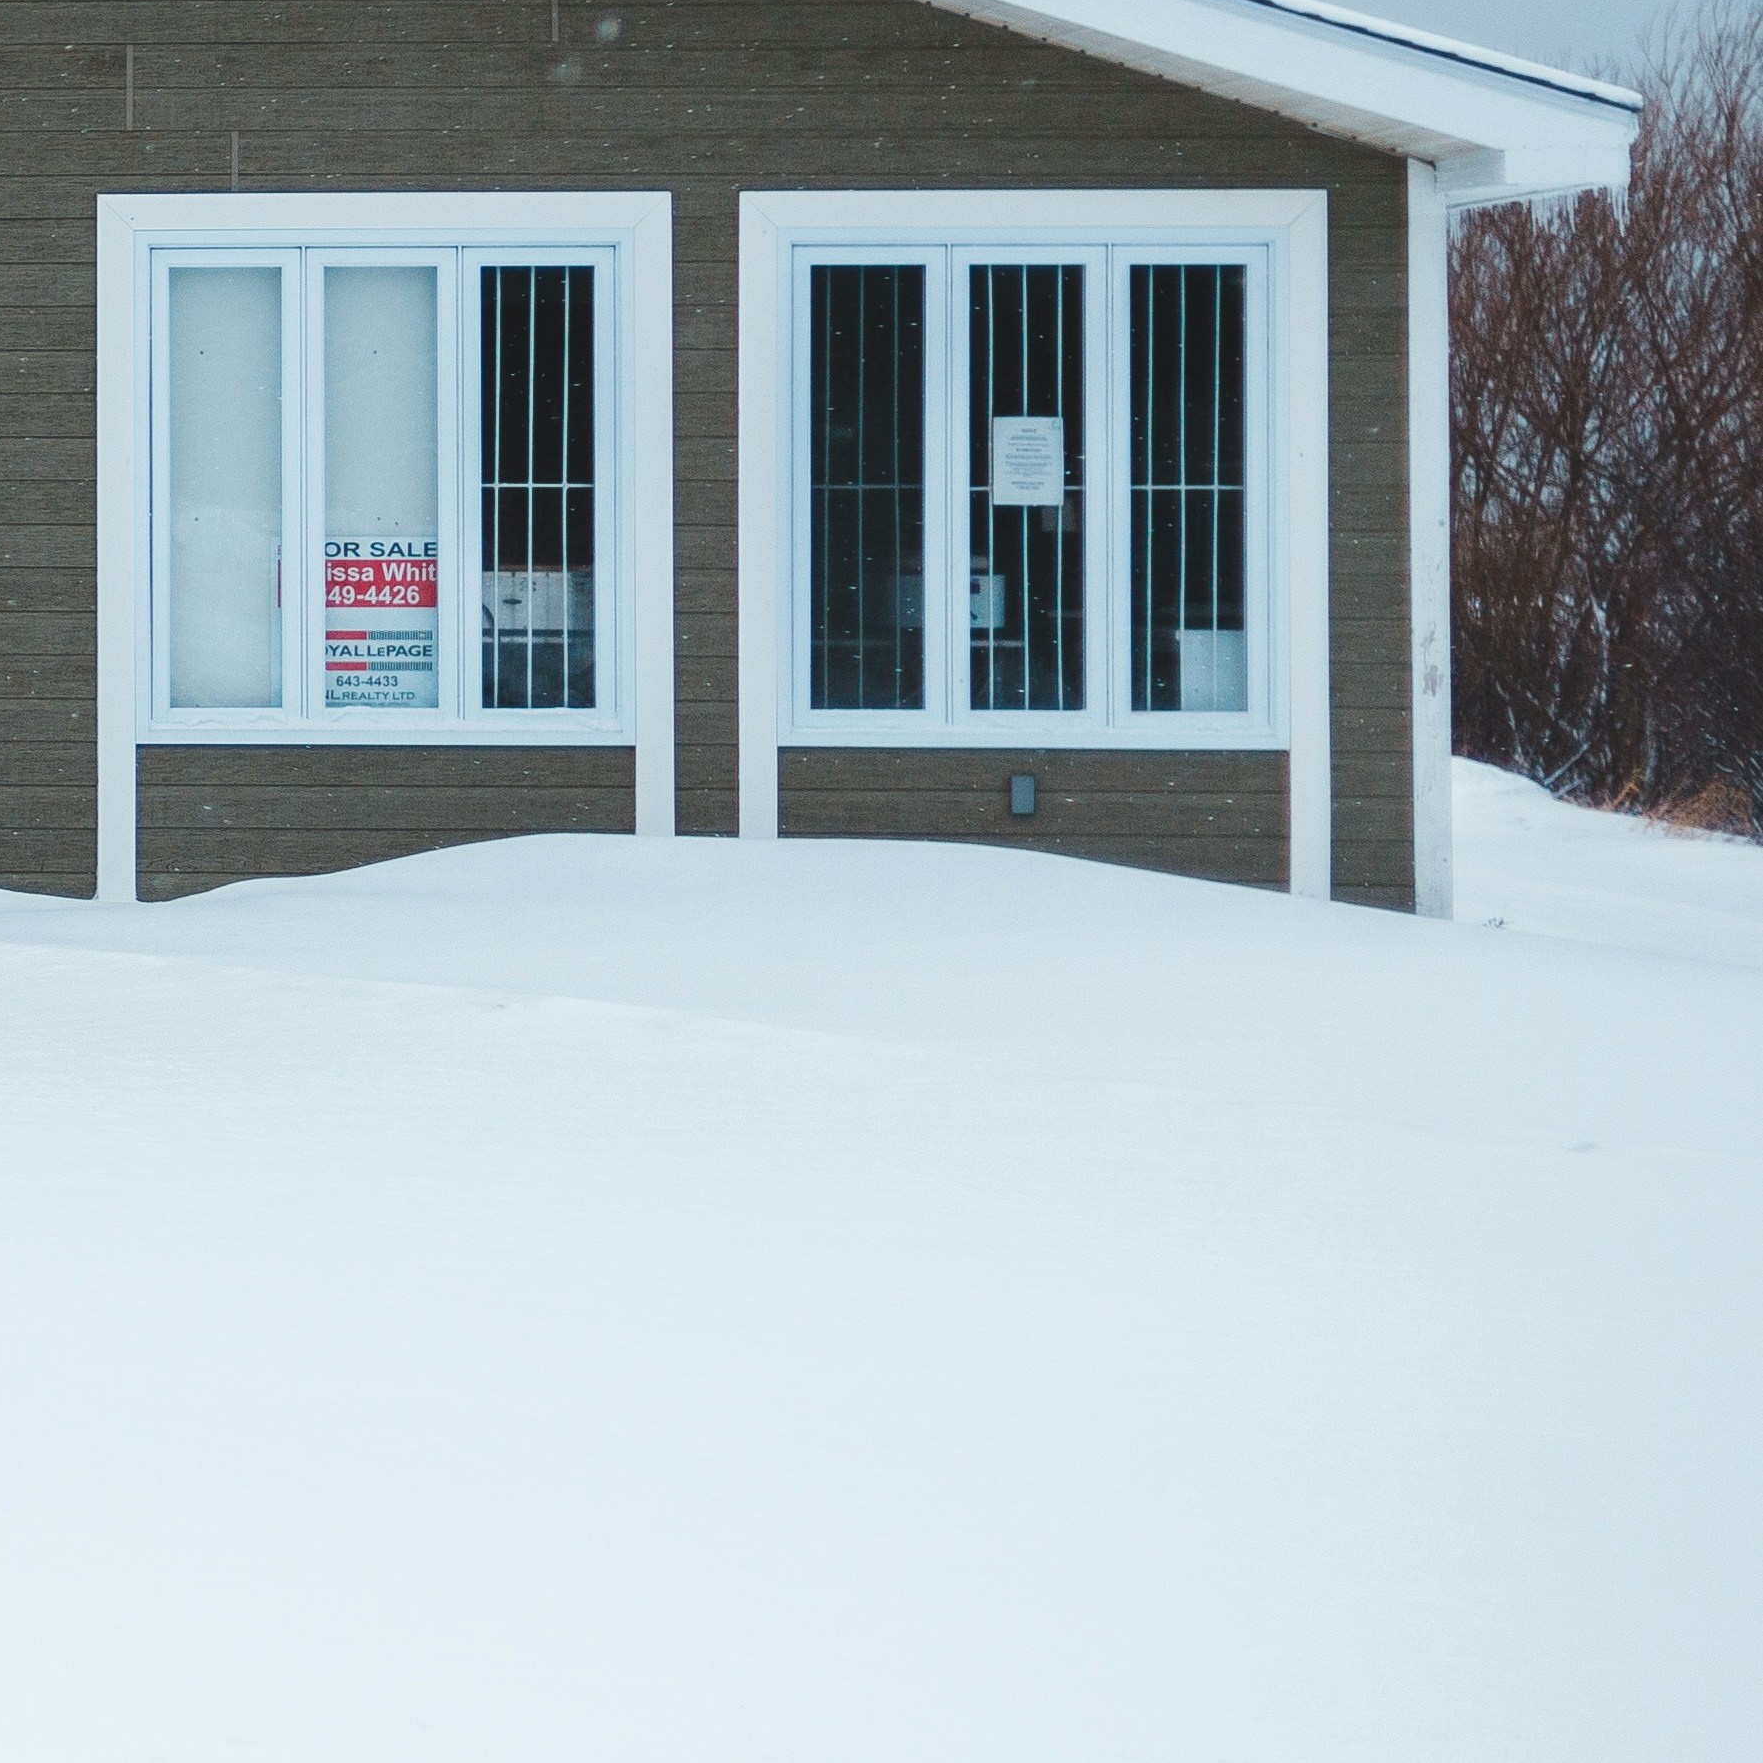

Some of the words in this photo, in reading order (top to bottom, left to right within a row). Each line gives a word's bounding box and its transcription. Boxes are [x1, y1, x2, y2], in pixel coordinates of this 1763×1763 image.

[325, 542, 360, 557] OR
[370, 542, 437, 557] SALE
[326, 563, 374, 582] issa
[381, 562, 436, 582] Whit
[325, 585, 420, 605] 49-4426
[325, 645, 364, 657] YAL
[336, 675, 398, 687] 643-4433
[342, 691, 389, 700] REALTY
[392, 691, 416, 700] LTD
